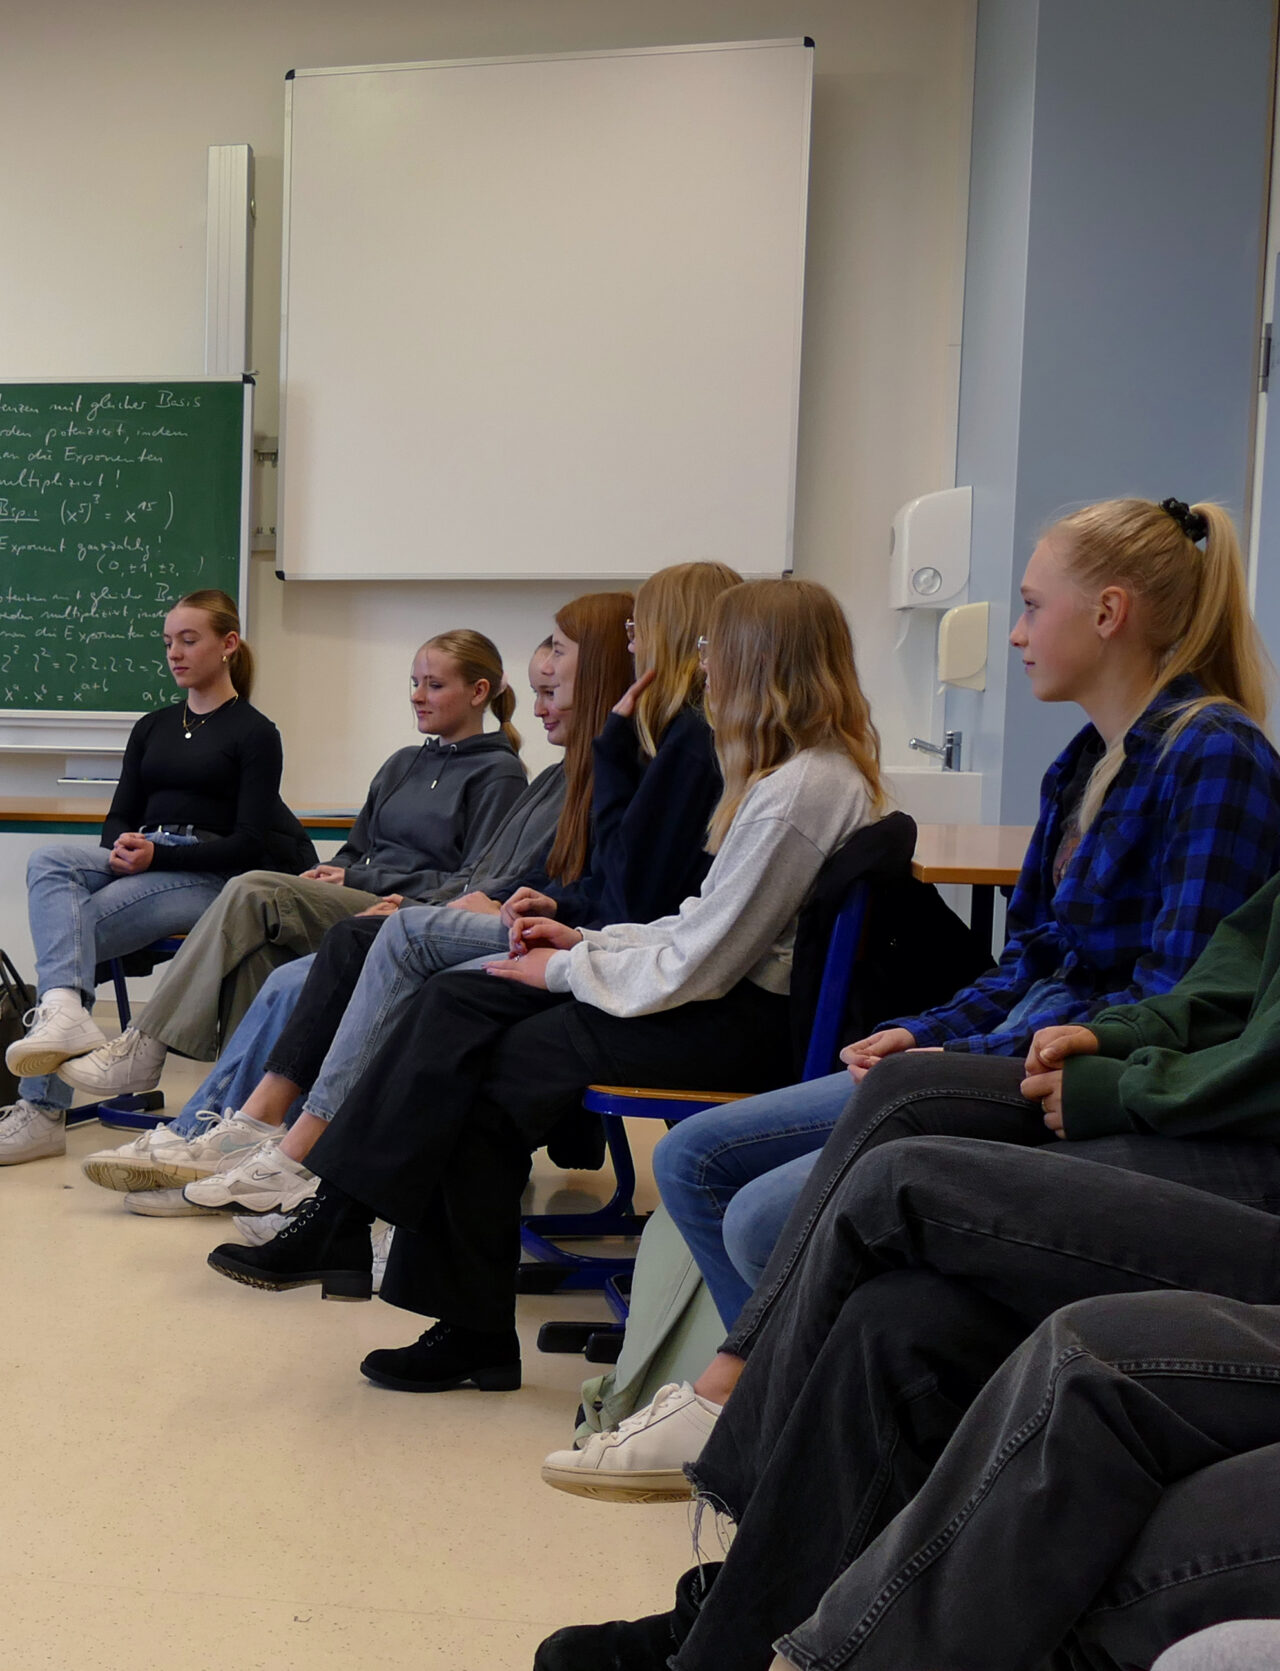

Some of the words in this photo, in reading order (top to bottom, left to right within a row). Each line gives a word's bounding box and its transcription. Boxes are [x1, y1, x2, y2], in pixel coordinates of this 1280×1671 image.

[49, 394, 82, 412] mit
[86, 393, 146, 421] gleicher
[155, 390, 201, 408] Basis
[45, 421, 129, 445] potenziert,
[137, 426, 188, 437] indem
[27, 448, 53, 461] die
[64, 446, 163, 465] Exponenten
[64, 625, 144, 644] Exponenten
